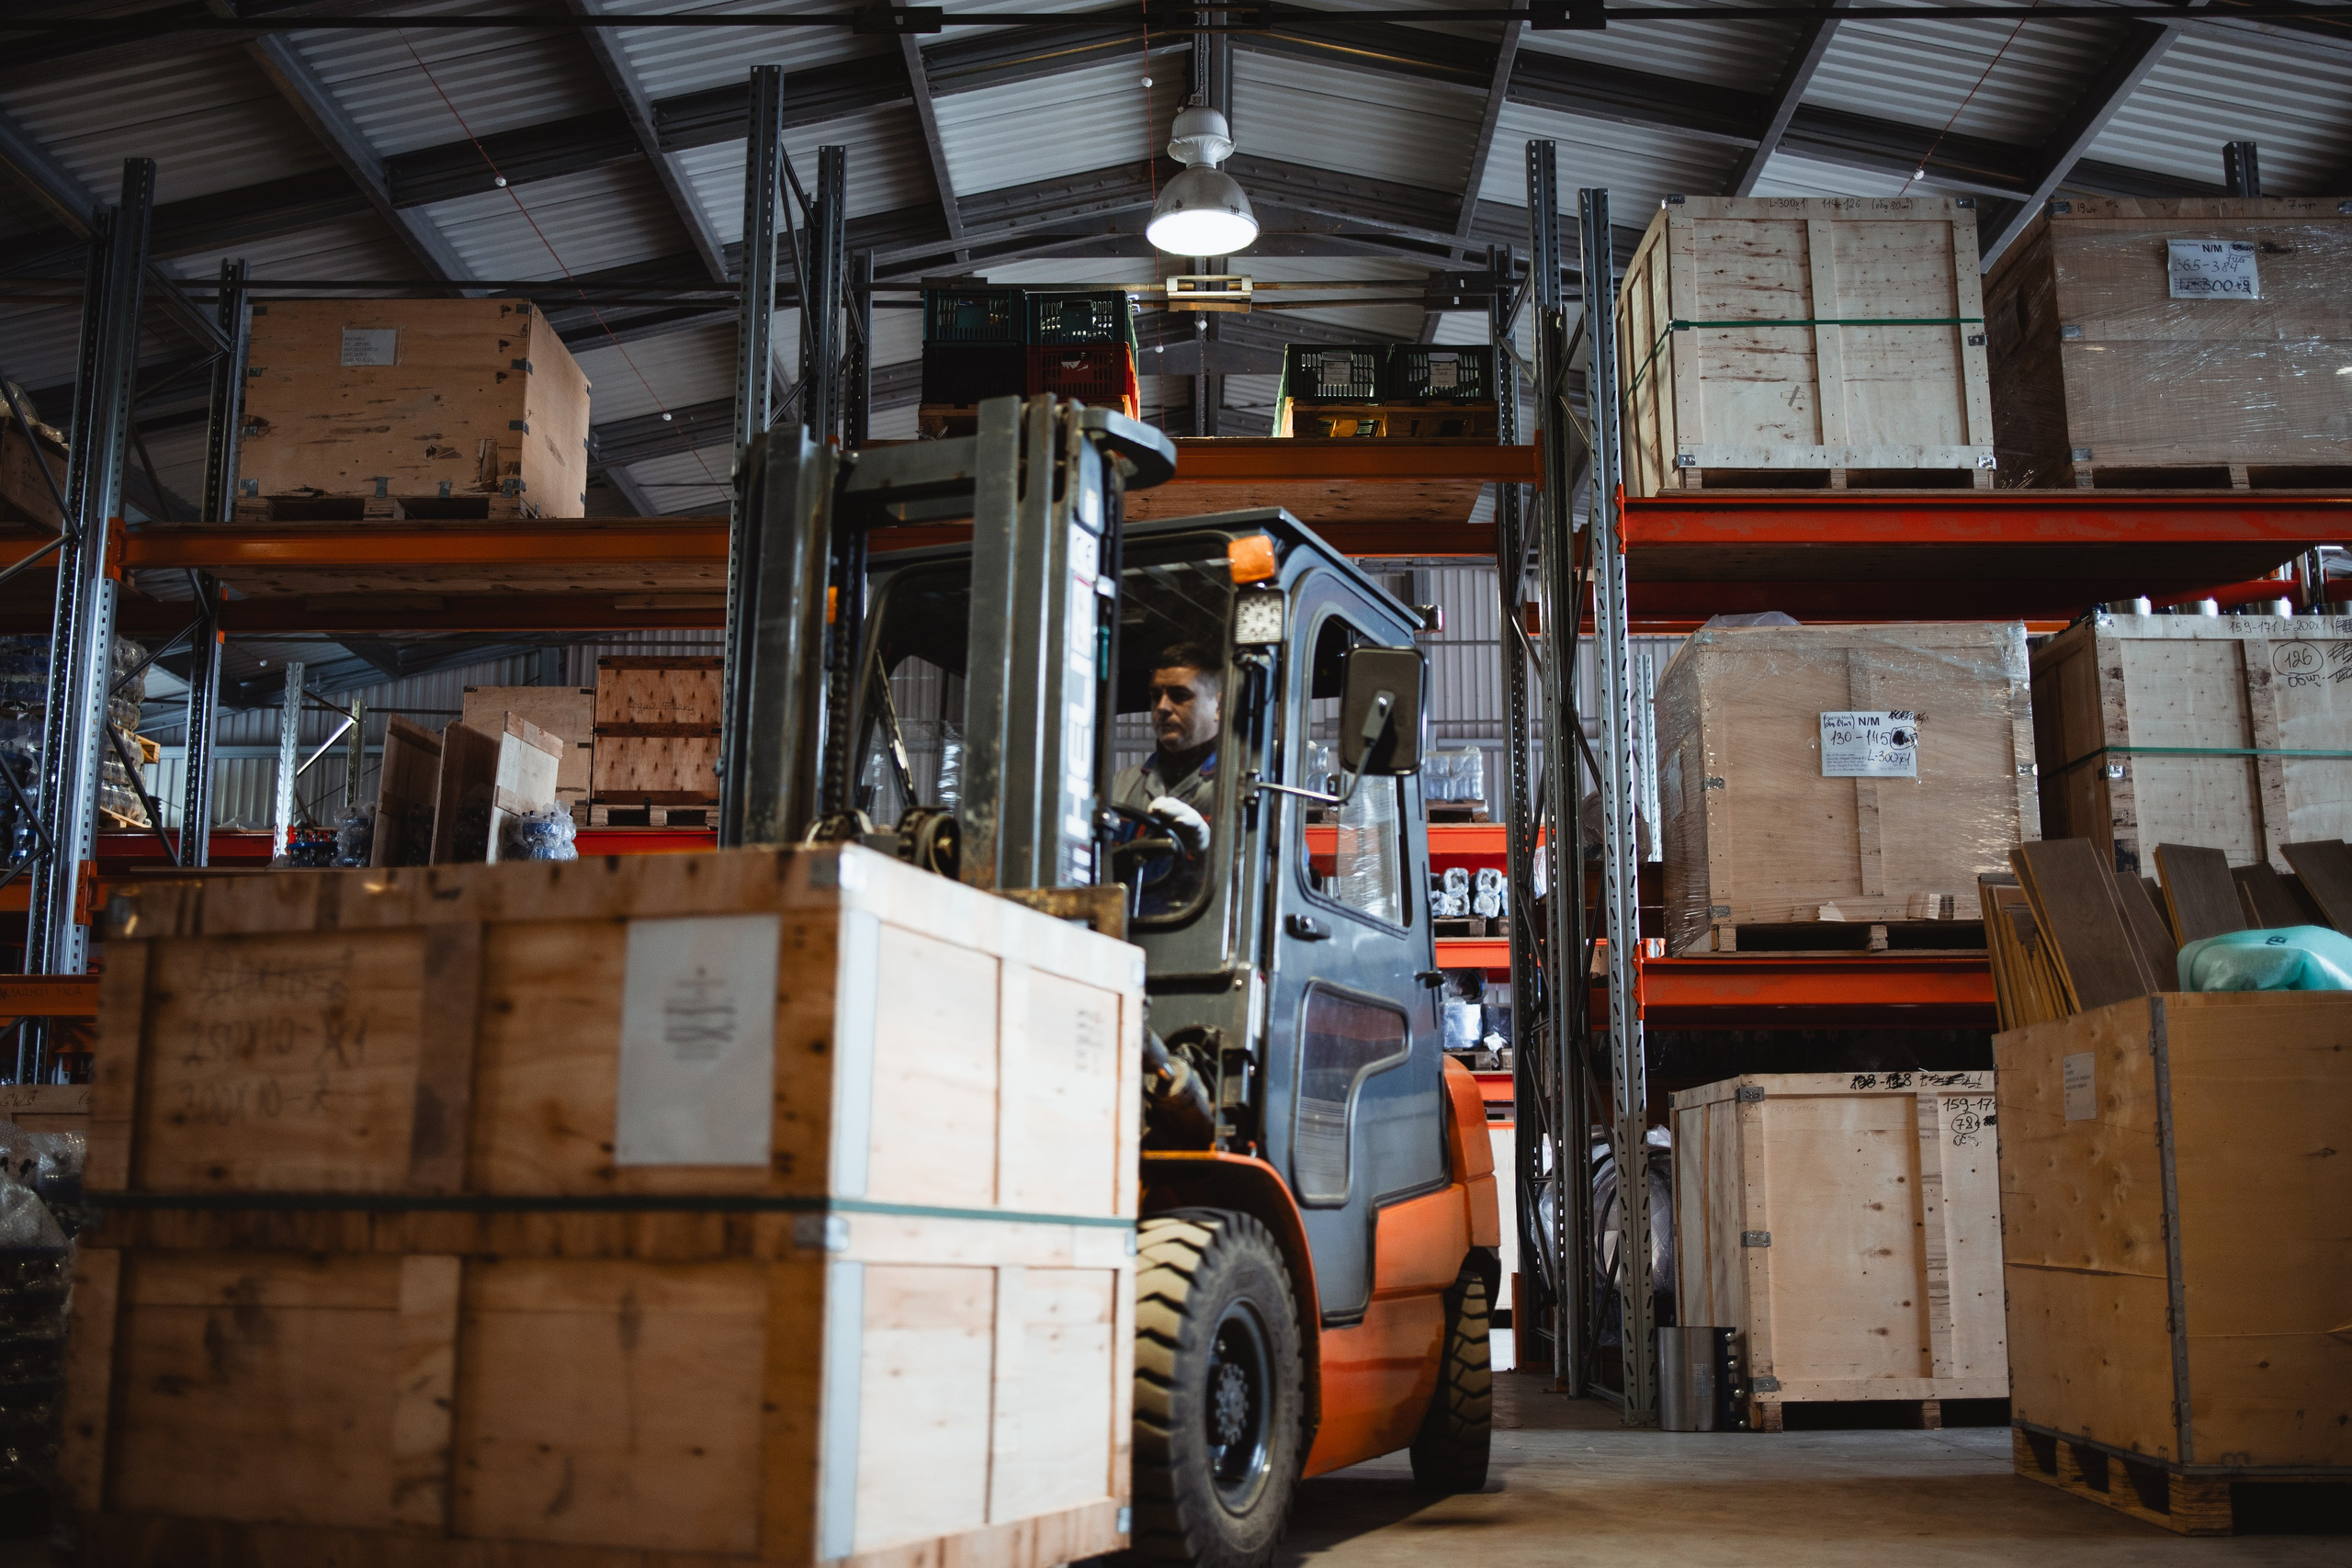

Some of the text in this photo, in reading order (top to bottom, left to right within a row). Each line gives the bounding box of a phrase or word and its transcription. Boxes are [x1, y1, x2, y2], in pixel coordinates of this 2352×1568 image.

[2202, 244, 2222, 254] N/M
[2174, 258, 2238, 273] 365-384
[2229, 621, 2278, 634] 159-171
[2284, 648, 2312, 669] 126
[1858, 716, 1880, 727] N/M
[1065, 650, 1093, 840] HELI
